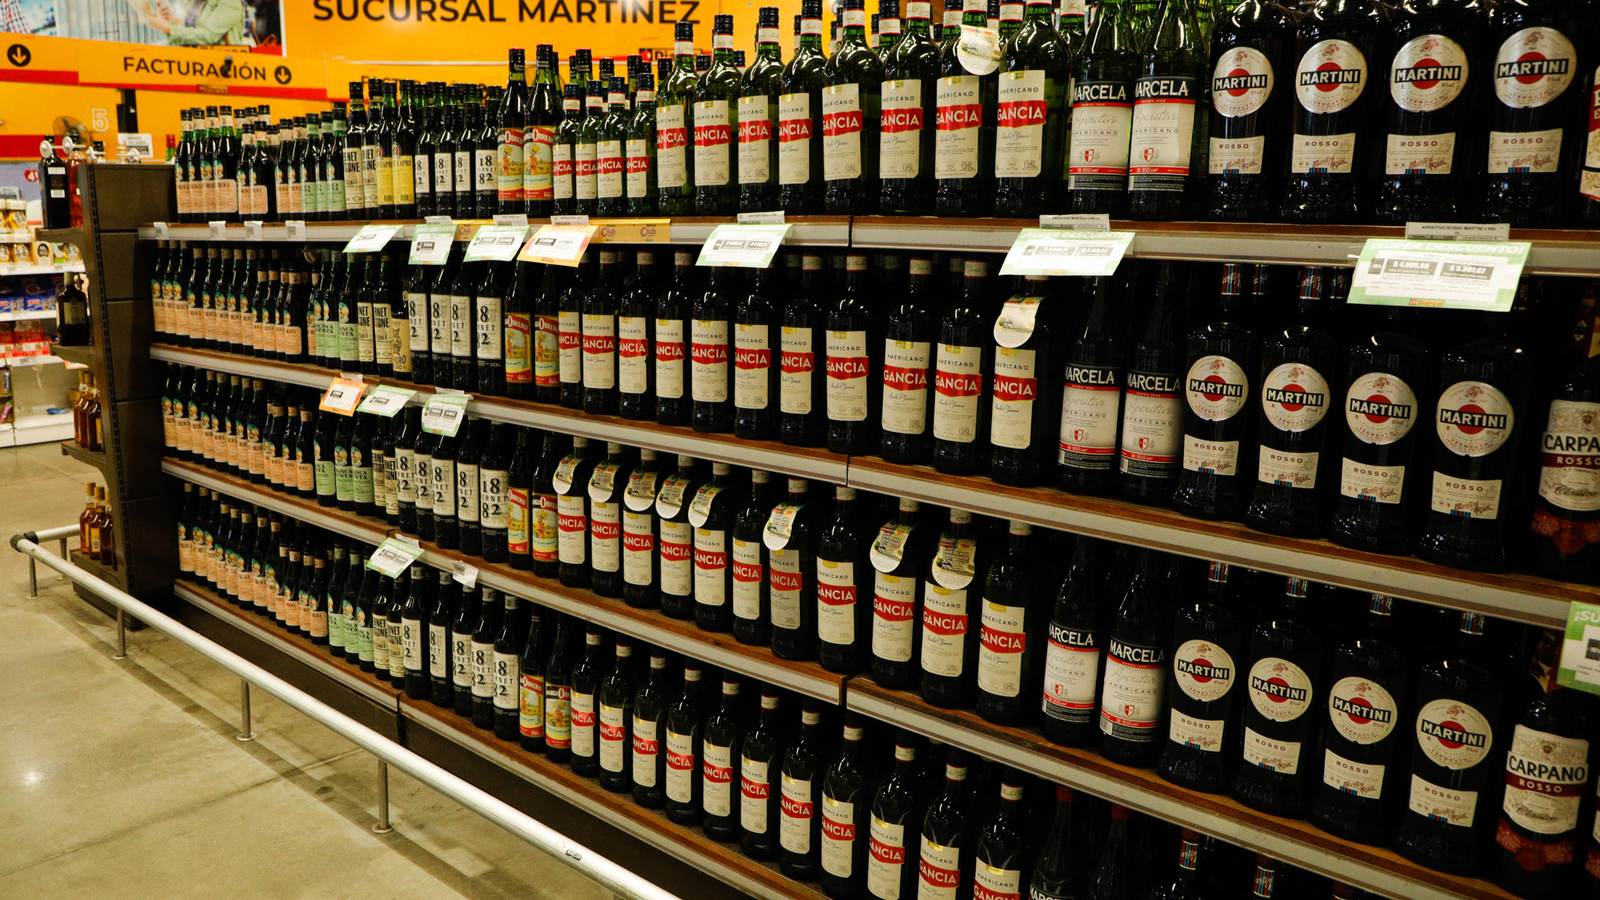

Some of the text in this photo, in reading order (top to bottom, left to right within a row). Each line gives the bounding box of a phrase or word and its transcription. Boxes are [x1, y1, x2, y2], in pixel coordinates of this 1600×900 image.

[313, 0, 507, 22] SUCURSAL
[1396, 67, 1459, 82] MARTINI
[1499, 60, 1567, 77] MARTINI
[1215, 75, 1267, 90] MARTINI
[1301, 70, 1360, 85] MARTINI
[997, 106, 1044, 121] GANCIA
[1503, 137, 1543, 145] ROSSO
[479, 154, 492, 167] 18
[597, 161, 622, 170] ANCIA
[619, 343, 646, 353] ANCIA
[656, 345, 683, 356] ANCIA
[781, 356, 812, 368] ANCIA
[884, 369, 928, 385] GANCIA
[935, 375, 978, 392] GANCIA
[1191, 380, 1241, 396] MARTINI
[1267, 389, 1322, 406] MARTINI
[1351, 400, 1409, 418] MARTINI
[1441, 409, 1505, 428] MARTINI
[1194, 442, 1224, 451] ROSSO
[1544, 433, 1600, 452] CARPA
[1270, 454, 1303, 464] ROSSO
[1353, 467, 1388, 478] ROSSO
[482, 477, 500, 494] 18
[1446, 481, 1484, 493] ROSSO
[482, 504, 502, 518] 82
[558, 518, 584, 529] ANCIA
[624, 537, 651, 548] ANCIA
[733, 566, 759, 578] ANCIA
[770, 574, 799, 588] ANCIA
[923, 610, 965, 630] GANCIA
[1574, 610, 1600, 623] ¡SU
[1110, 639, 1165, 663] MARCELA
[1179, 660, 1228, 679] MARTINI
[1253, 677, 1305, 701] MARTINI
[1334, 699, 1390, 722] MARTINI
[1181, 717, 1210, 729] ROSSO
[600, 727, 623, 738] ANCIA
[1423, 721, 1485, 746] MARTINI
[633, 740, 656, 752] ANCIA
[1255, 738, 1286, 751] ROSSO
[667, 754, 691, 767] ANCIA
[1336, 760, 1369, 775] ROSSO
[1508, 754, 1585, 781] CARPANO
[704, 767, 730, 780] ANCIA
[742, 782, 767, 796] ANCIA
[1519, 778, 1563, 793] ROSSO
[781, 800, 810, 815] ANCIA
